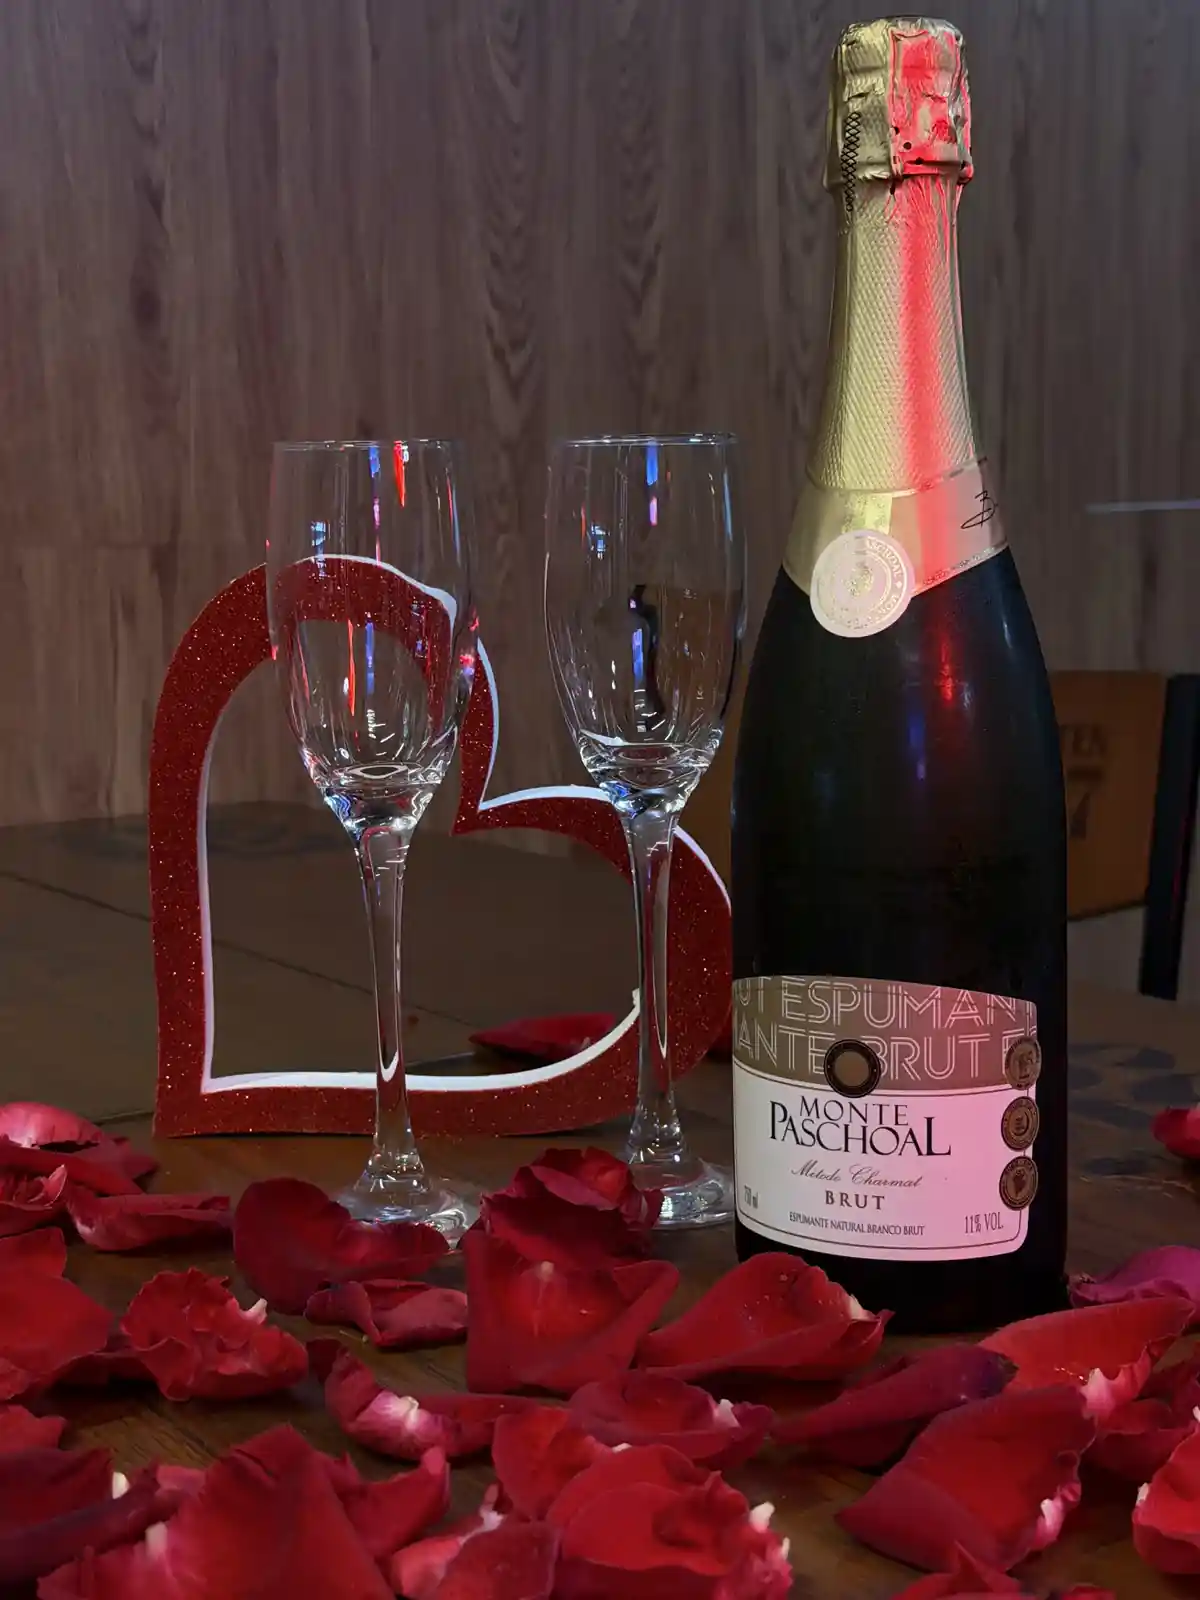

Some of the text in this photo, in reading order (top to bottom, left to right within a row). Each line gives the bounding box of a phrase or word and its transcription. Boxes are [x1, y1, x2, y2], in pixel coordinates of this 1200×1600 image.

[734, 976, 772, 1014] UT
[734, 1008, 836, 1075] ANTE
[799, 1095, 909, 1126] MONTE
[769, 1100, 952, 1156] PASCHOAL
[848, 1163, 923, 1188] Charmat
[825, 1190, 885, 1210] BRUT
[789, 1211, 926, 1236] ESPUMANTE NATURAL BRANCO BRUT
[965, 1213, 982, 1234] 11%
